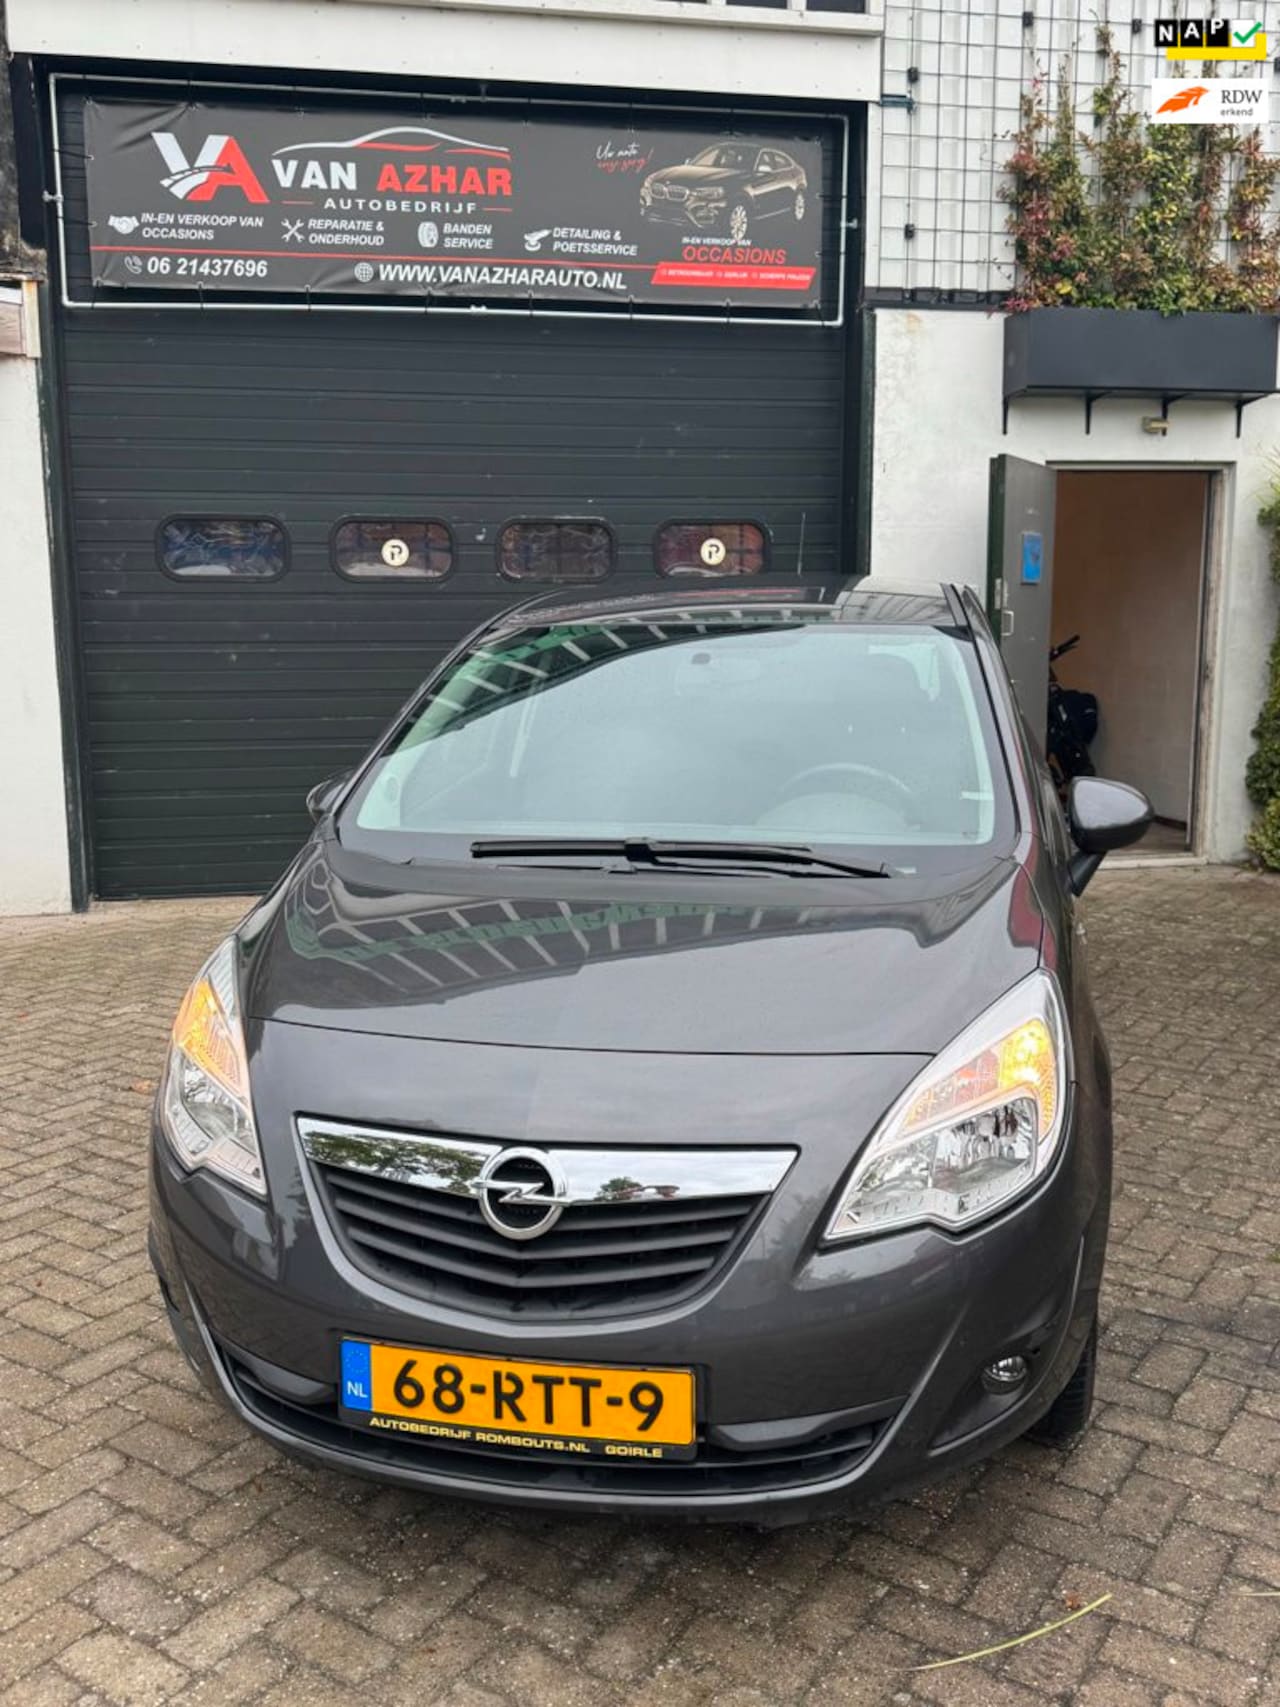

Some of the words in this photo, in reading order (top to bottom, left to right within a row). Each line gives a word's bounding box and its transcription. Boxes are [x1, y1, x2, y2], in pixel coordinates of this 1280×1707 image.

[271, 158, 357, 191] VAN
[376, 163, 513, 196] AZHAR
[323, 198, 477, 214] AUTOBEDRIJF
[140, 212, 175, 225] IN-EN
[177, 213, 238, 226] VERKOOP
[239, 215, 264, 227] VAN
[308, 218, 373, 232] REPARATIE
[375, 221, 385, 232] &
[141, 227, 215, 240] OCCASIONS
[443, 222, 493, 235] BANDEN
[552, 227, 612, 241] DETAILING
[613, 230, 622, 241] &
[308, 233, 385, 247] ONDERHOUD
[443, 237, 494, 249] SERVICE
[552, 240, 638, 256] POETSSERVICE
[682, 245, 788, 265] OCCASIONS
[146, 256, 171, 274] 06
[176, 257, 269, 278] 21437696
[378, 263, 628, 290] WWW.VANAZHARAUTO.NL
[346, 1380, 369, 1399] NL
[393, 1359, 665, 1432] 68-RTT-9
[369, 1415, 472, 1439] AUTOBEDRIJF
[475, 1431, 591, 1454] ROMBOUTS.NL
[604, 1444, 664, 1459] GOIRLE
